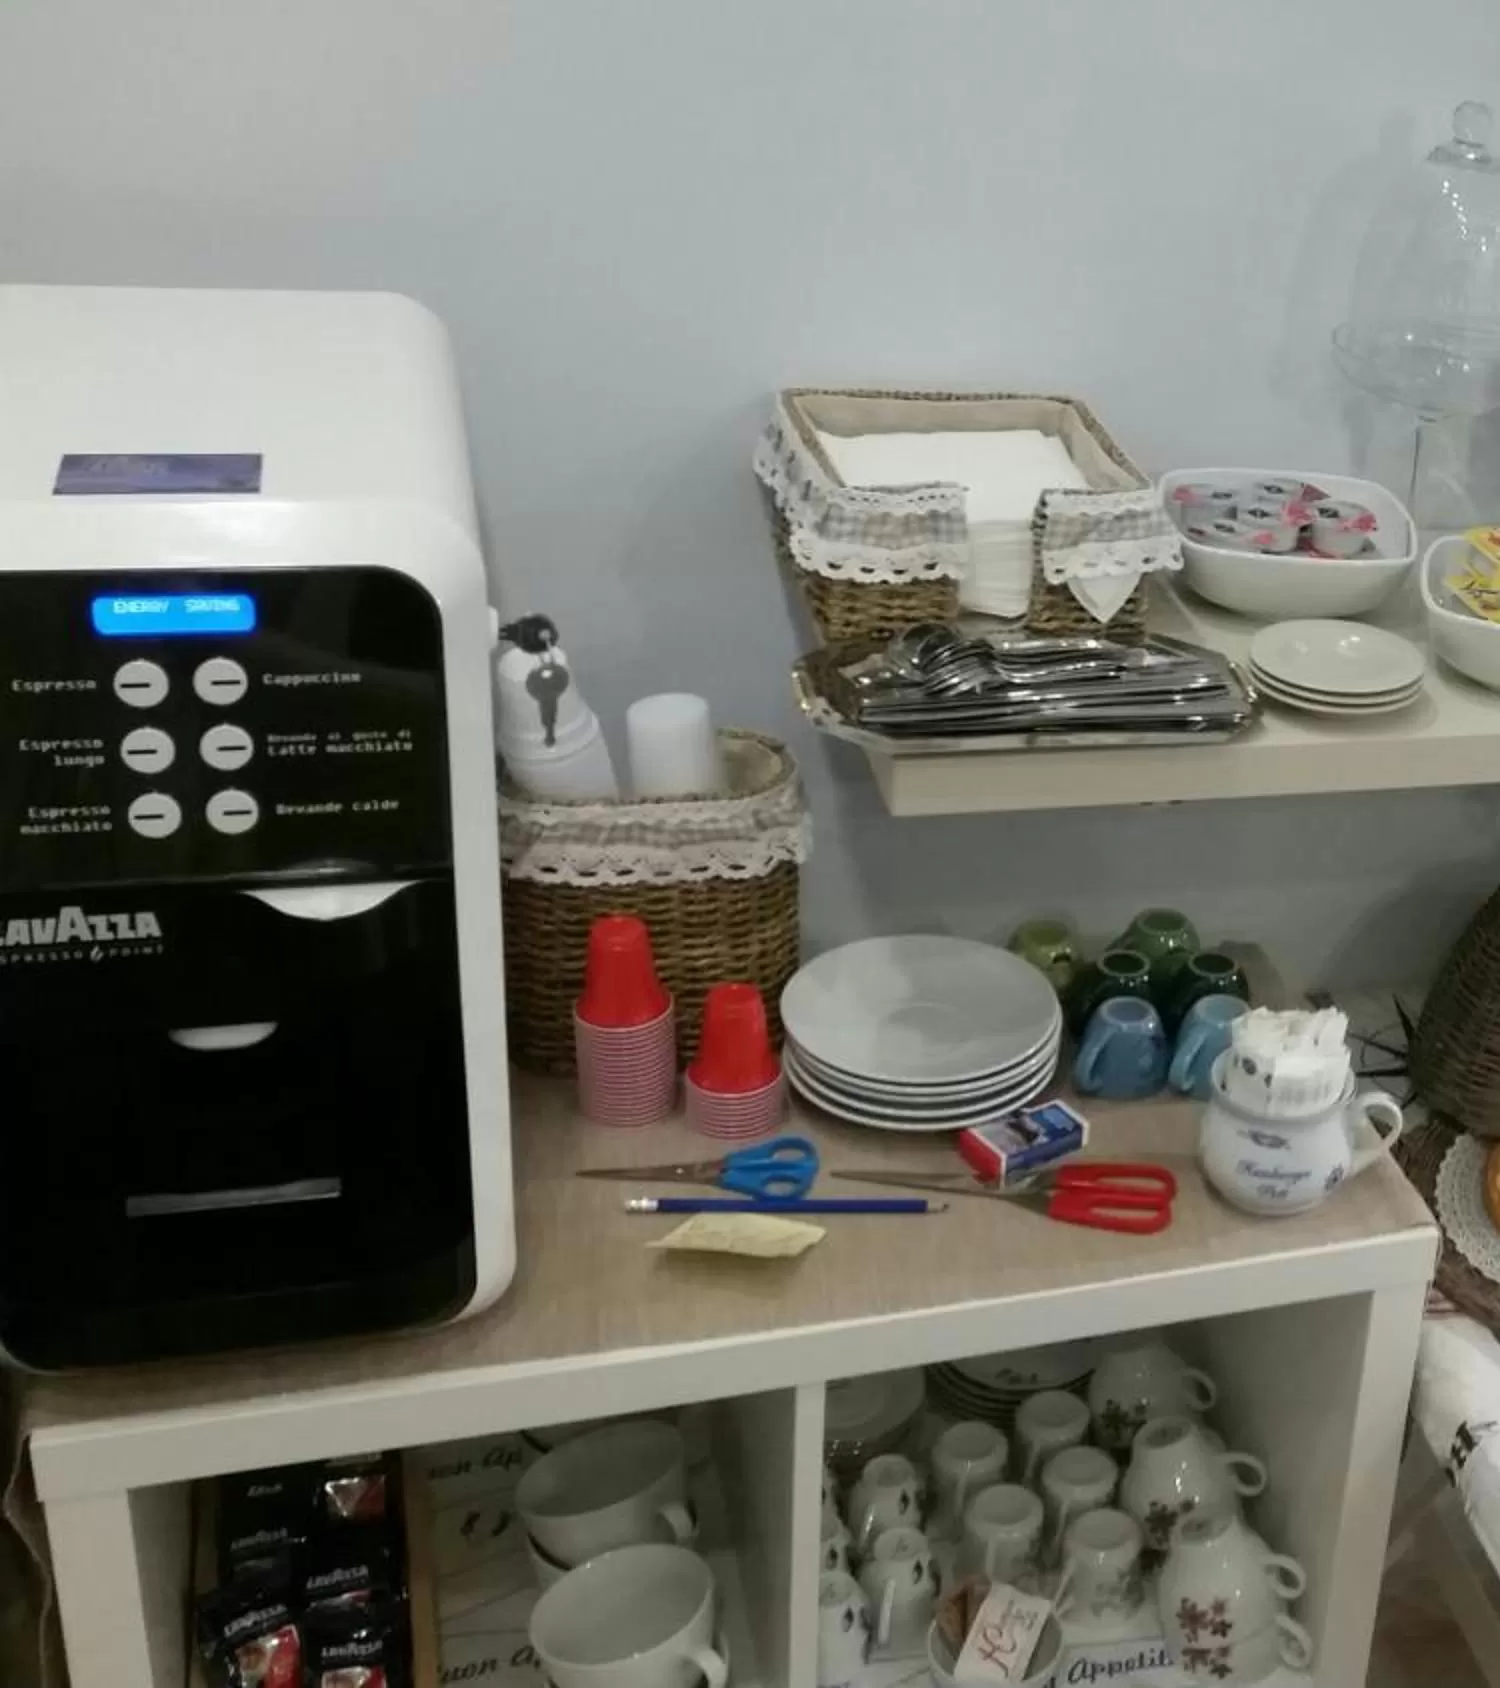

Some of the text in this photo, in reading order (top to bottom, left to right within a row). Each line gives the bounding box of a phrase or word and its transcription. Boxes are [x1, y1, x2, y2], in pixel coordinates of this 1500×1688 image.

[11, 678, 97, 693] Espresso
[262, 672, 362, 687] Cappuccino
[19, 738, 104, 752] Espresso
[54, 754, 106, 768] lungo
[28, 805, 112, 819] Espresso
[20, 820, 114, 835] macchiato
[0, 904, 163, 947] AVAZZA
